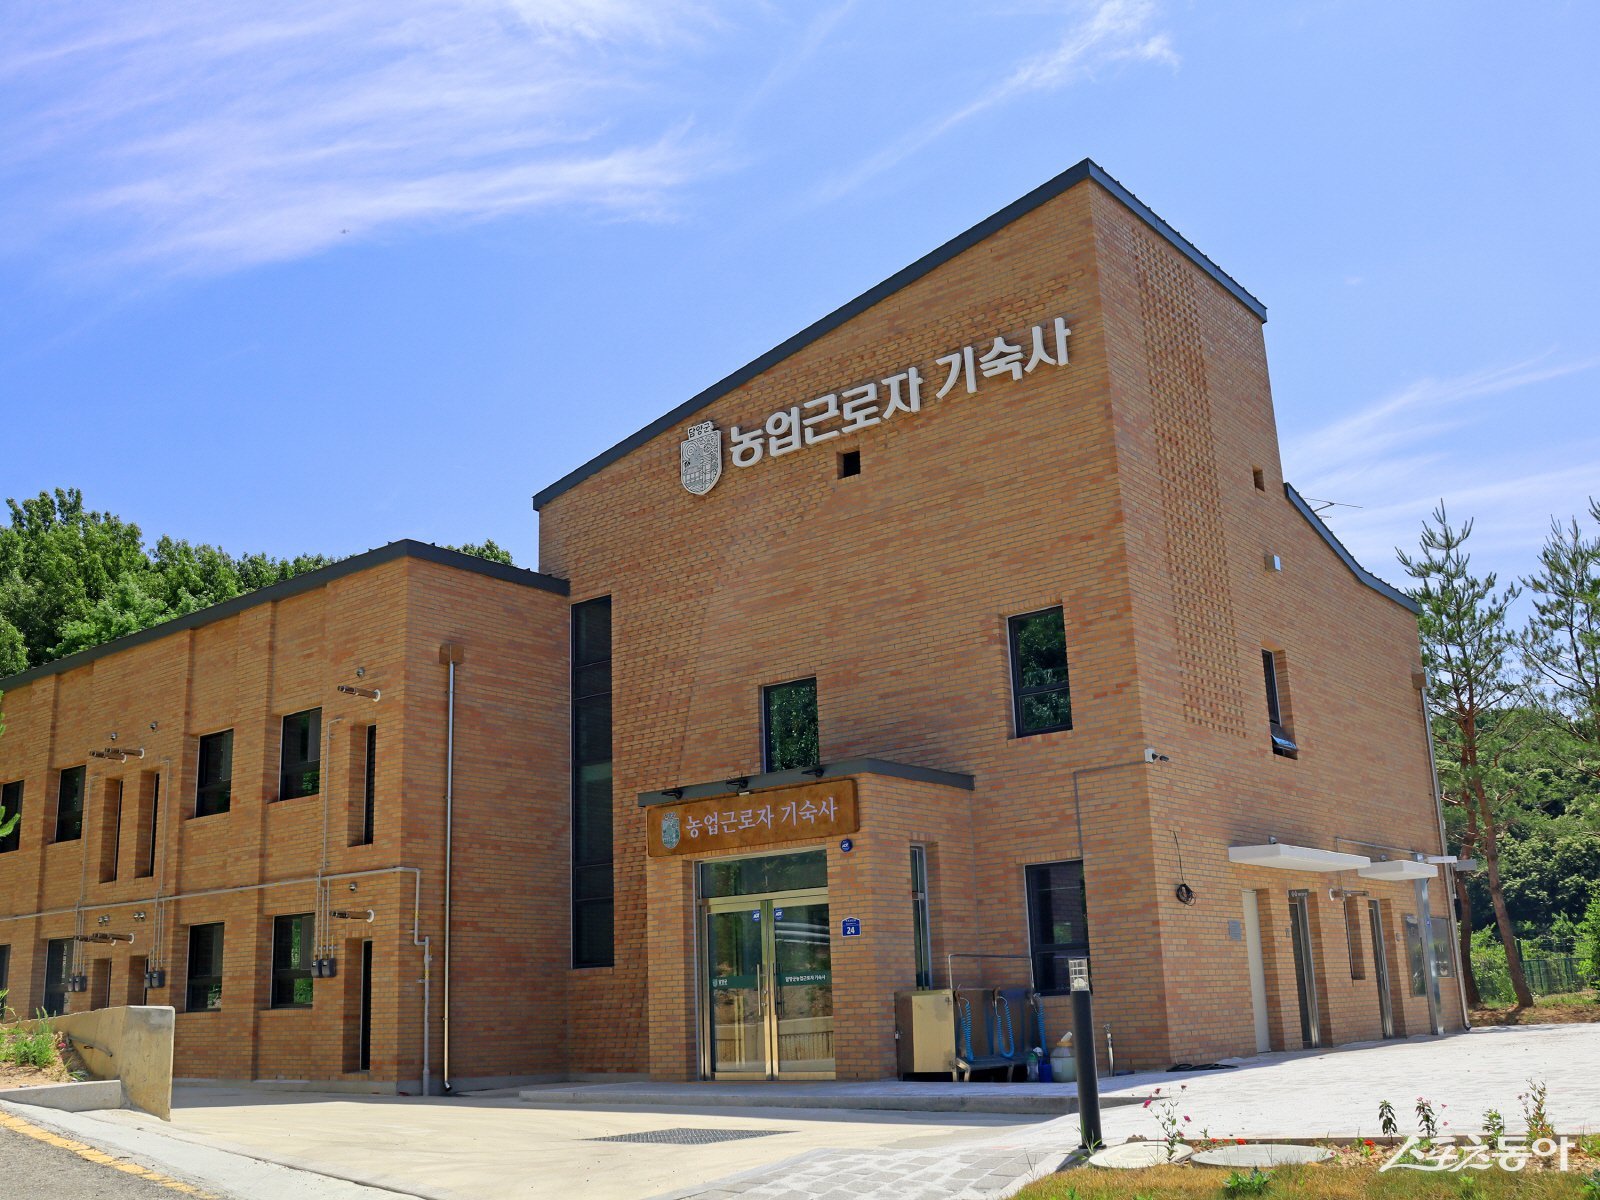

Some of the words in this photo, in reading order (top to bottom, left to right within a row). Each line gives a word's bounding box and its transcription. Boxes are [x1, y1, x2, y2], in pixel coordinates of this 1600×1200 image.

[729, 366, 924, 468] 농업근로자
[935, 317, 1072, 399] 기숙사
[689, 422, 711, 438] 담양군
[685, 804, 775, 838] 농업근로자
[781, 796, 839, 827] 기숙사
[846, 926, 855, 934] 24
